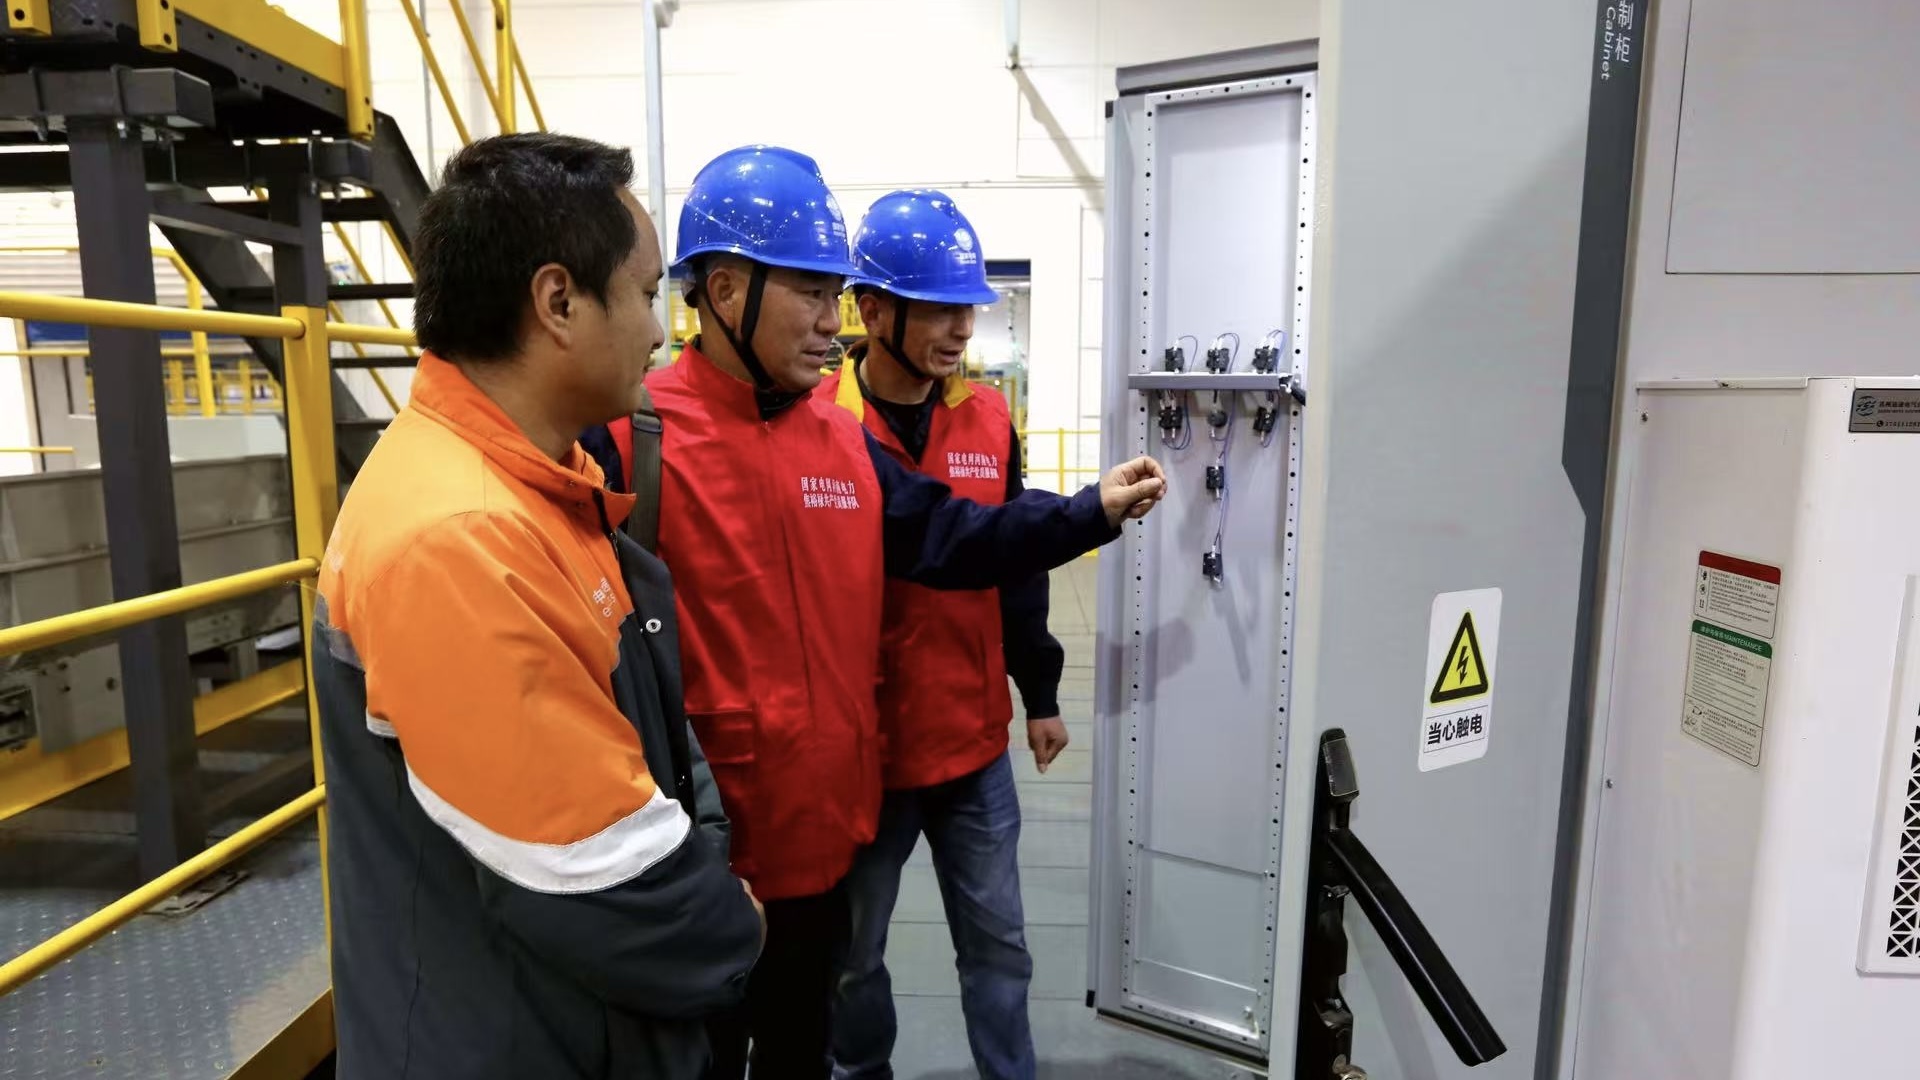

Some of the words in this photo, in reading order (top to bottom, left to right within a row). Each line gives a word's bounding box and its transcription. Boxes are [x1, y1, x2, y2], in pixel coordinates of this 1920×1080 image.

[1601, 6, 1616, 81] Cabinet
[1427, 713, 1483, 745] 当心触电
